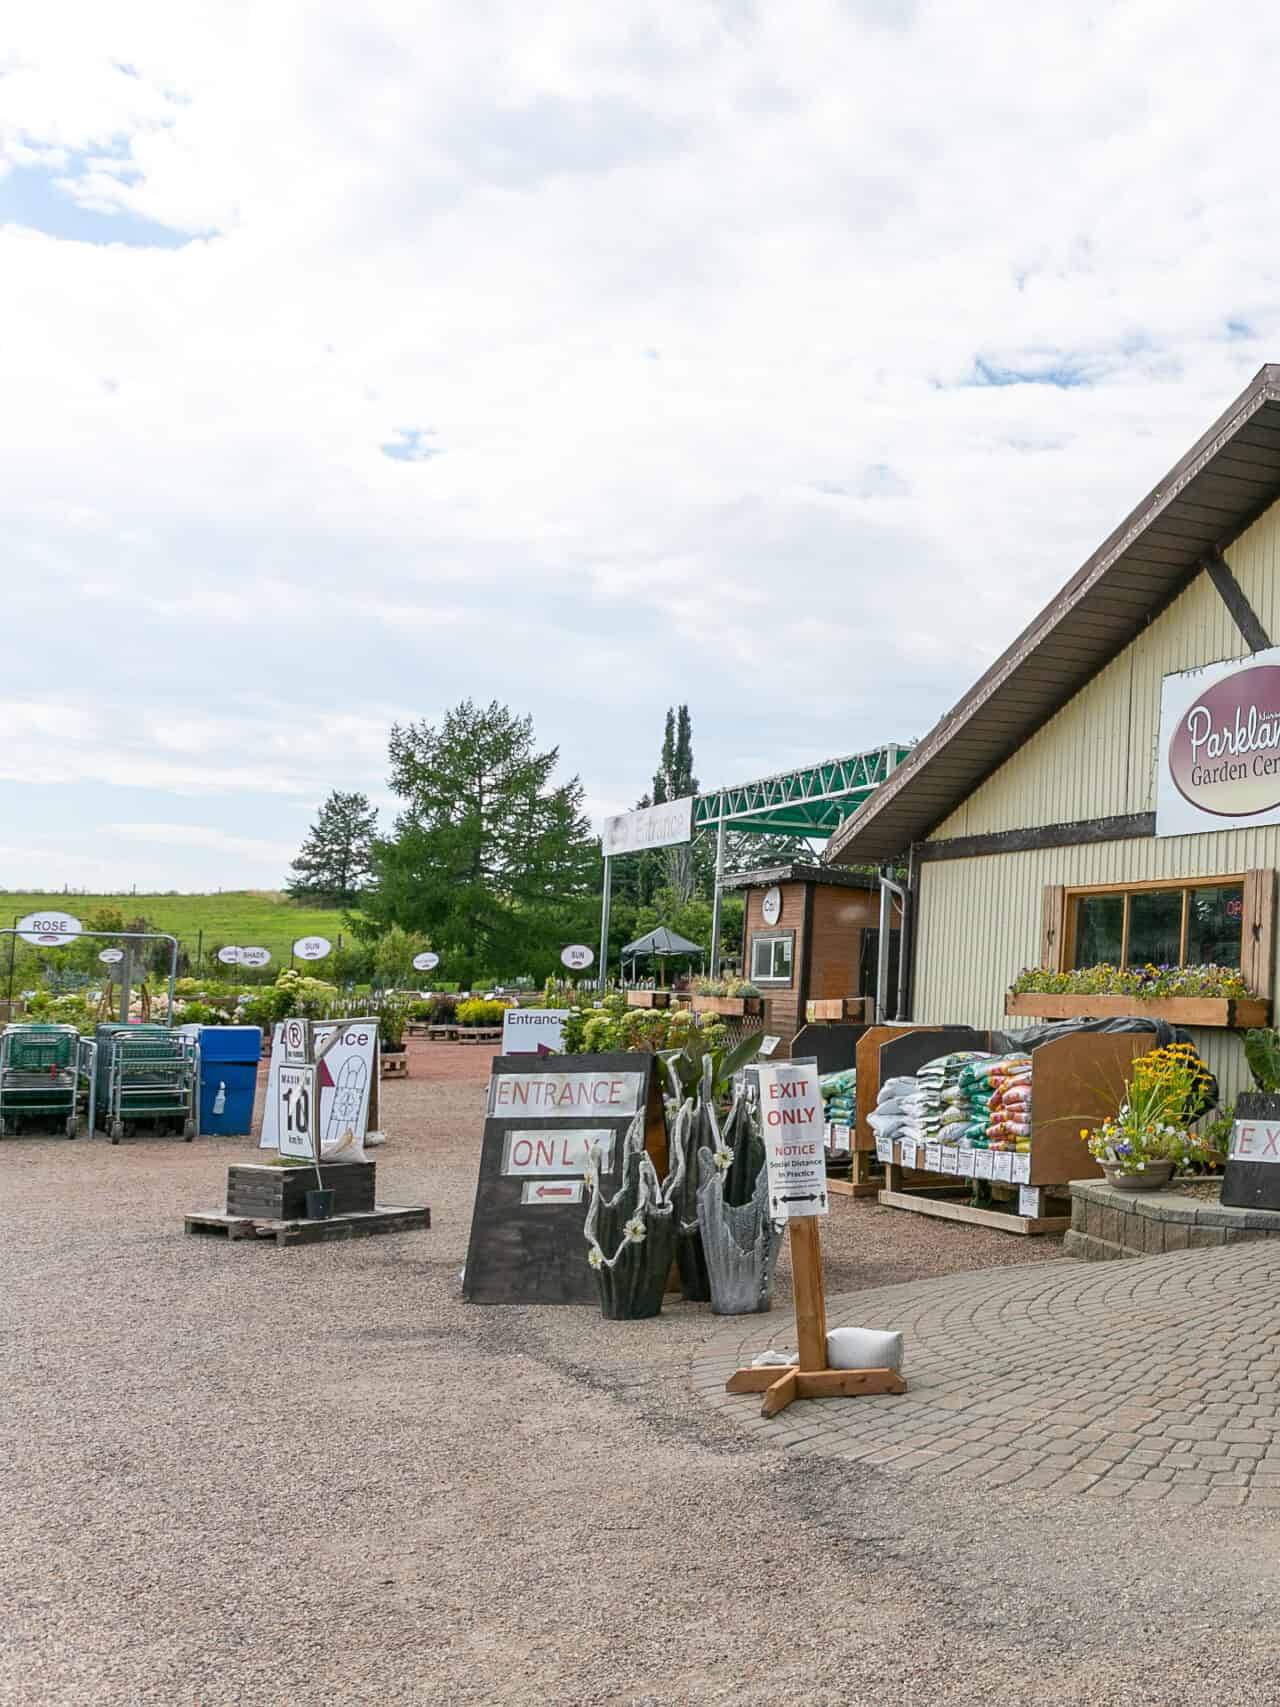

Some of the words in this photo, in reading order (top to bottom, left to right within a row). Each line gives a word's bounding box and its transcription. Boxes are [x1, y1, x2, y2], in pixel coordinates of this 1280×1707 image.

[1191, 761, 1247, 786] Garden
[32, 920, 68, 932] ROSE
[571, 951, 585, 960] SUN
[508, 1012, 562, 1025] Entranc
[497, 1080, 624, 1105] ENTRANCE
[769, 1081, 809, 1099] EXIT
[282, 1087, 309, 1133] 10
[767, 1107, 816, 1126] ONLY
[775, 1144, 816, 1157] NOTICE
[769, 1159, 790, 1169] Social
[791, 1158, 822, 1168] Distance
